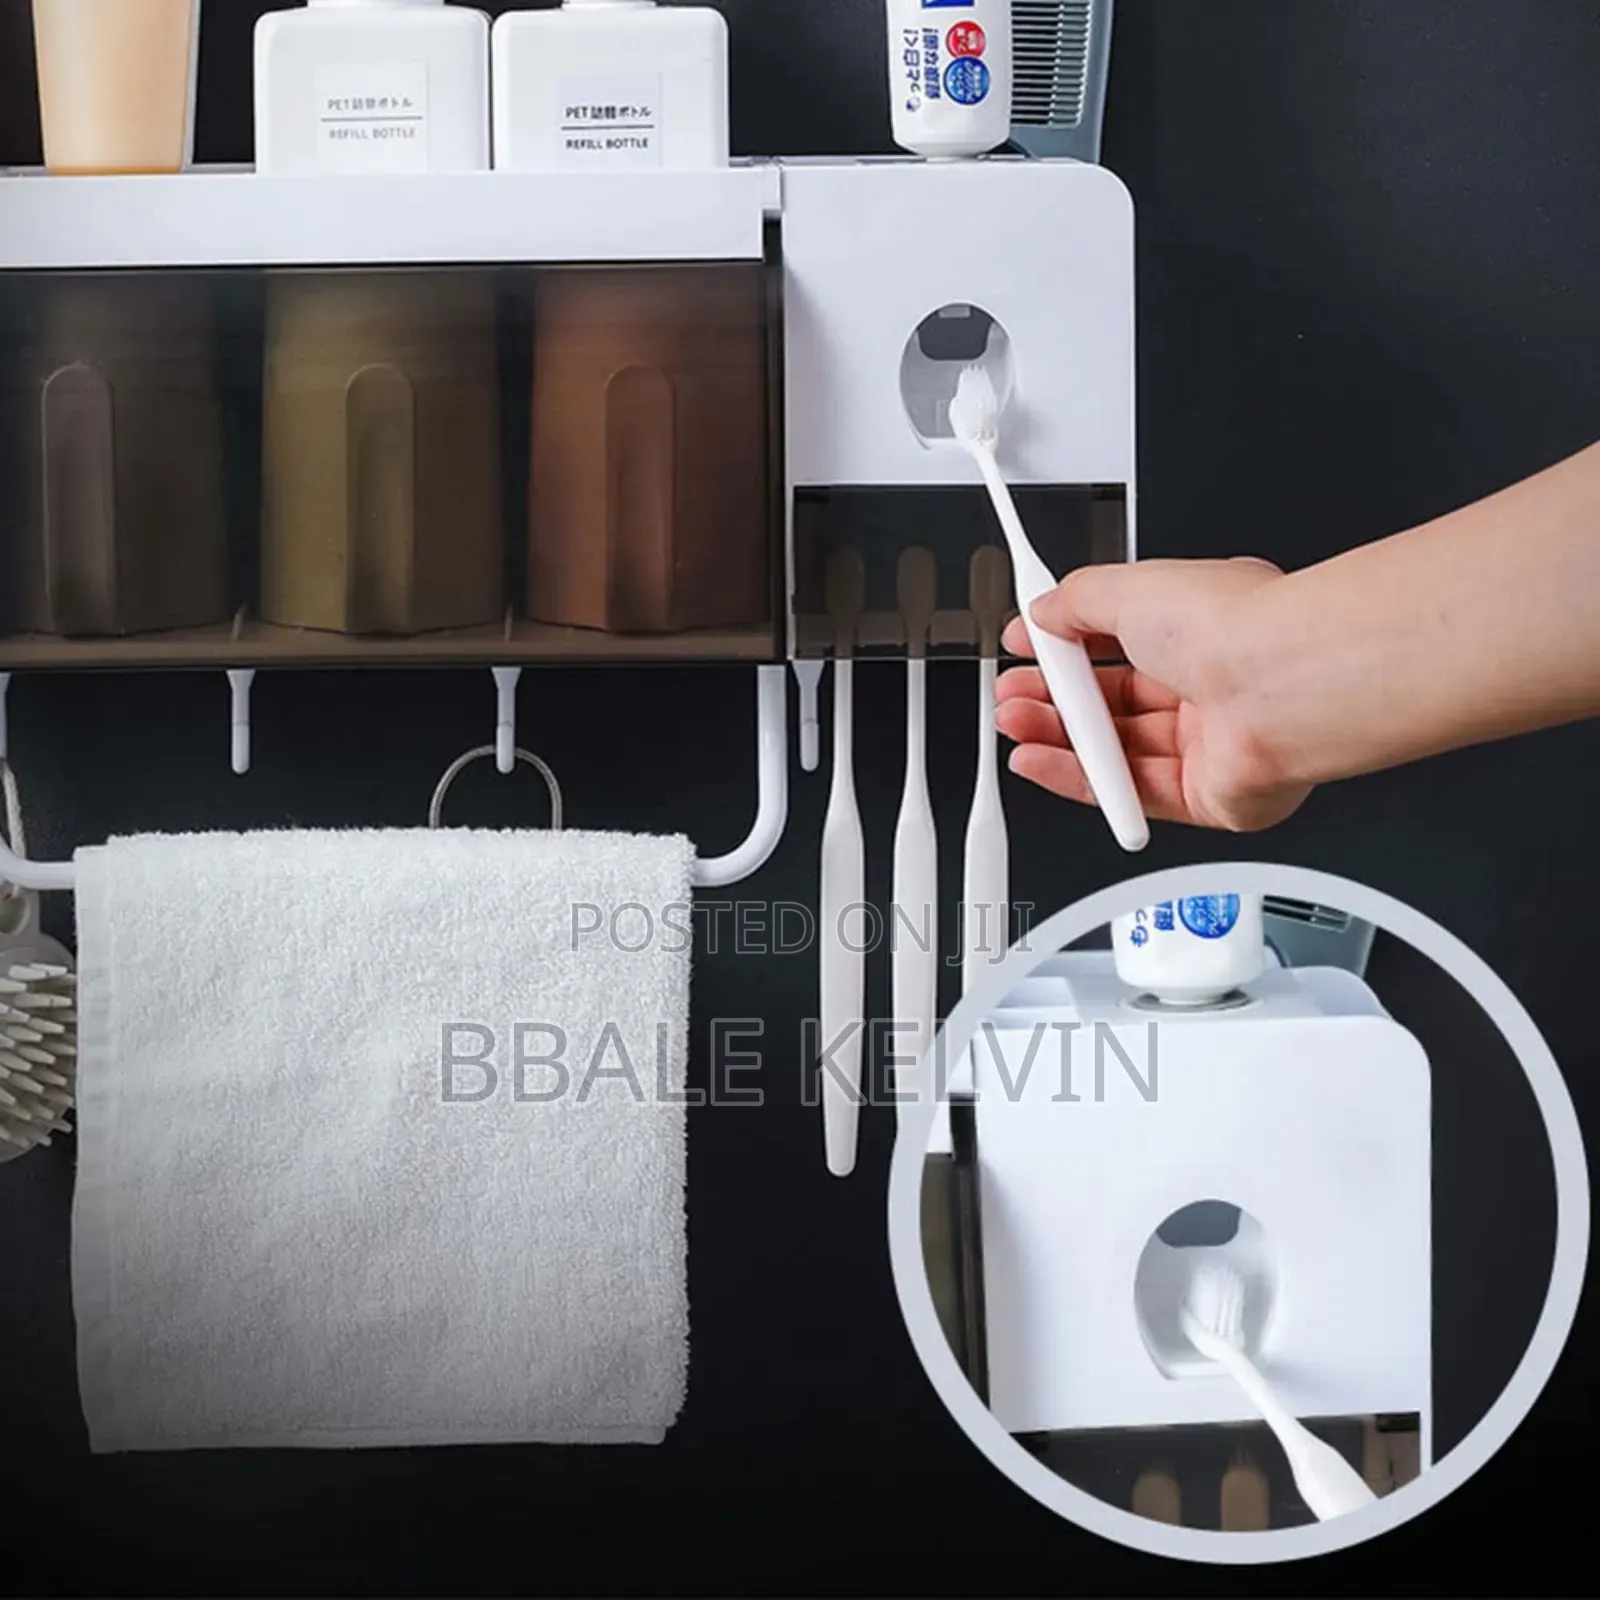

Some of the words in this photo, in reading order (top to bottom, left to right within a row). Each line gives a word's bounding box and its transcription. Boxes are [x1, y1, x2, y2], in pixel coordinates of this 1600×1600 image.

[329, 128, 368, 139] REFILL
[373, 126, 416, 139] BOTTLE
[565, 138, 603, 149] REFILL
[606, 137, 649, 149] BOTTLE
